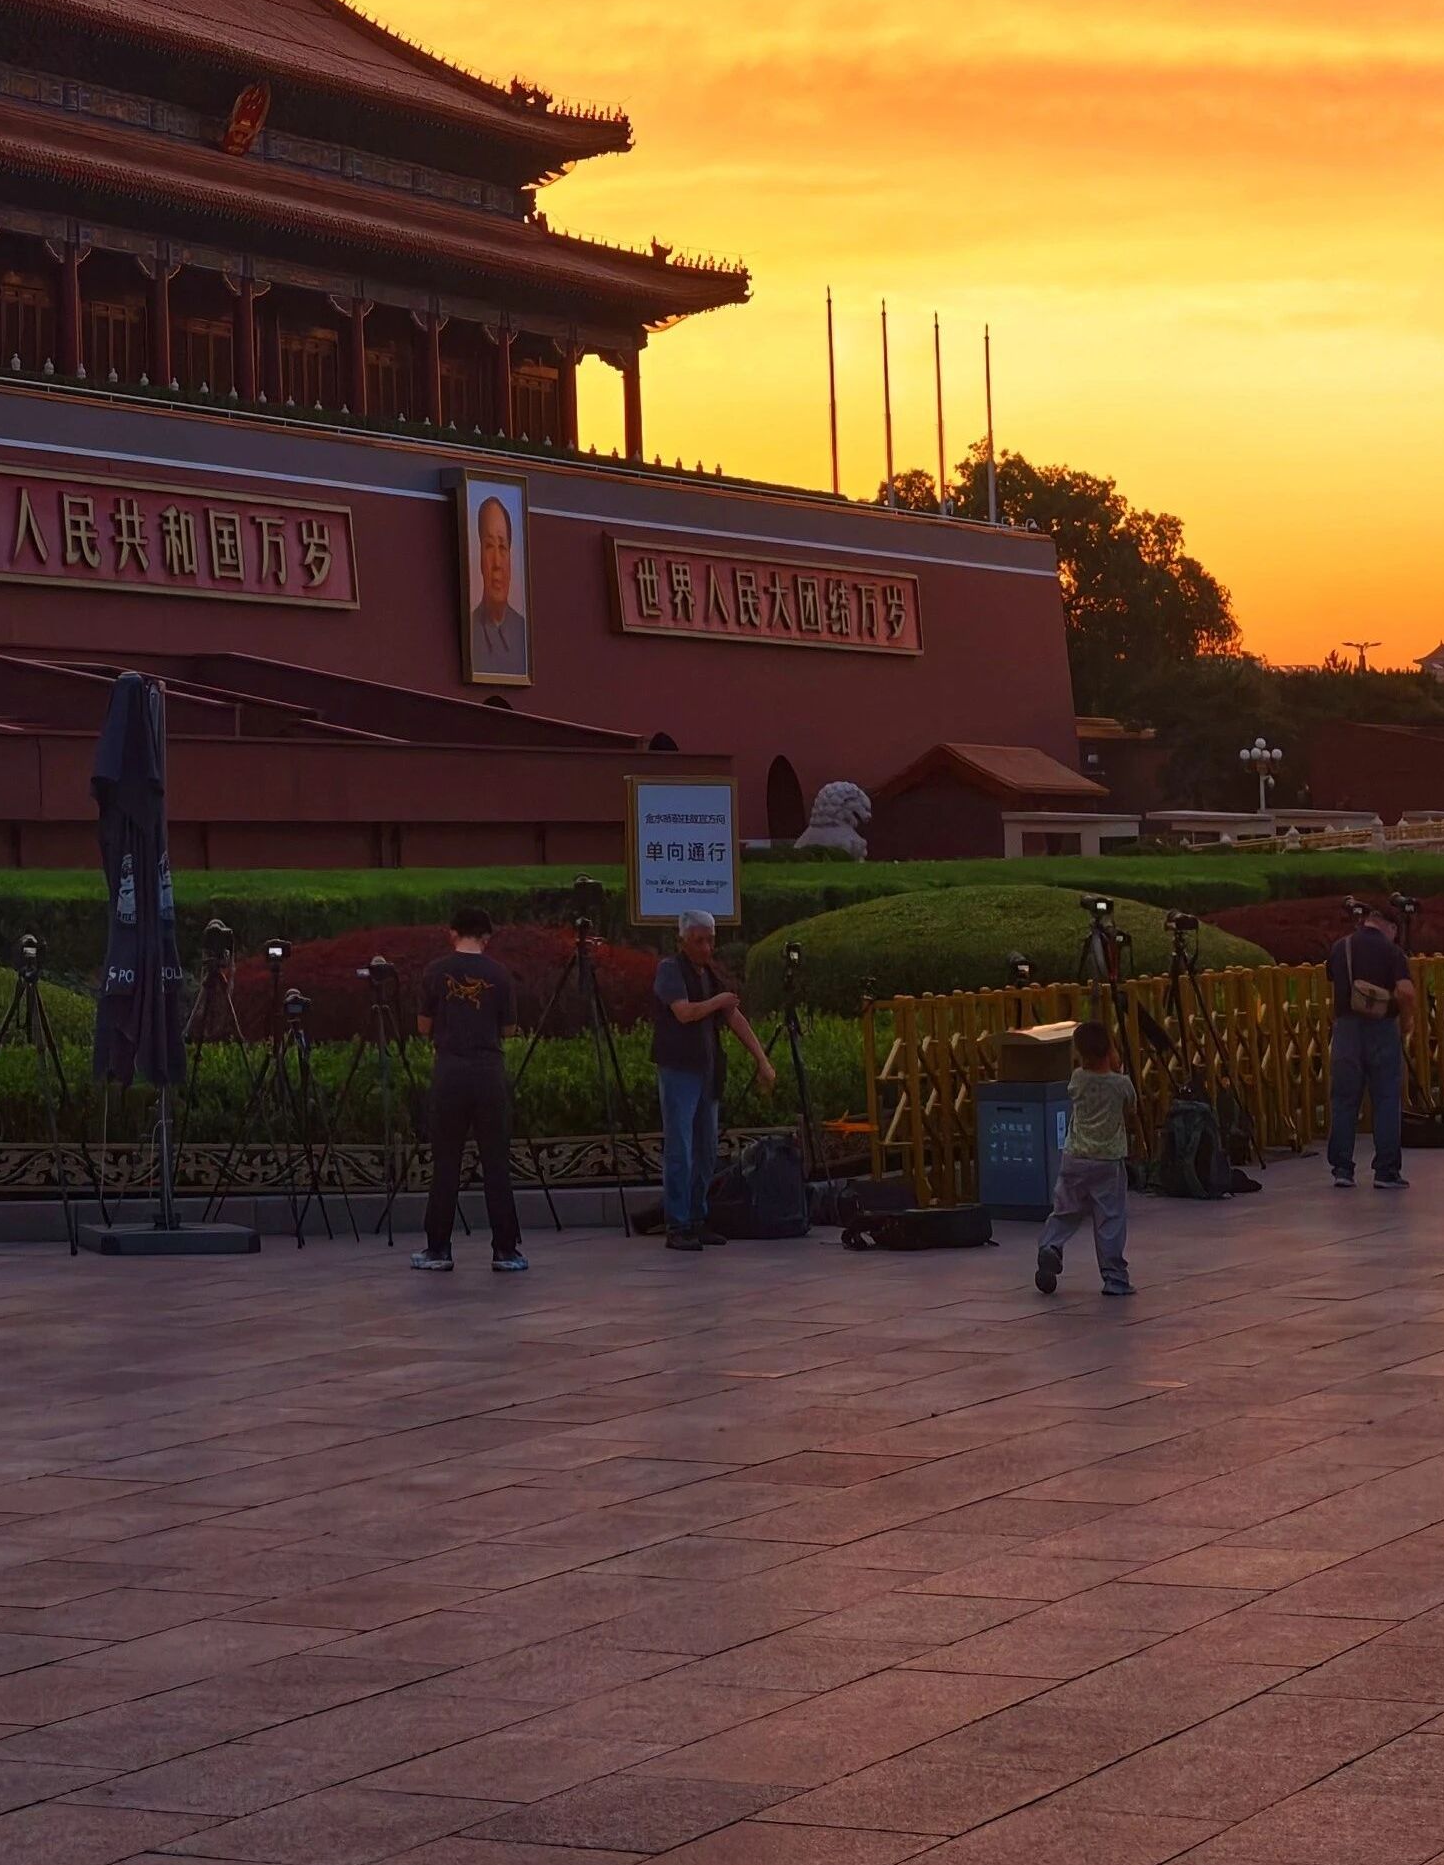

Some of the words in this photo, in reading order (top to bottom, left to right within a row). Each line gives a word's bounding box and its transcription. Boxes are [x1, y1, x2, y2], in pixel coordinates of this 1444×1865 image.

[635, 556, 907, 641] 世界人民大团结万岁
[645, 841, 726, 862] 单向通行
